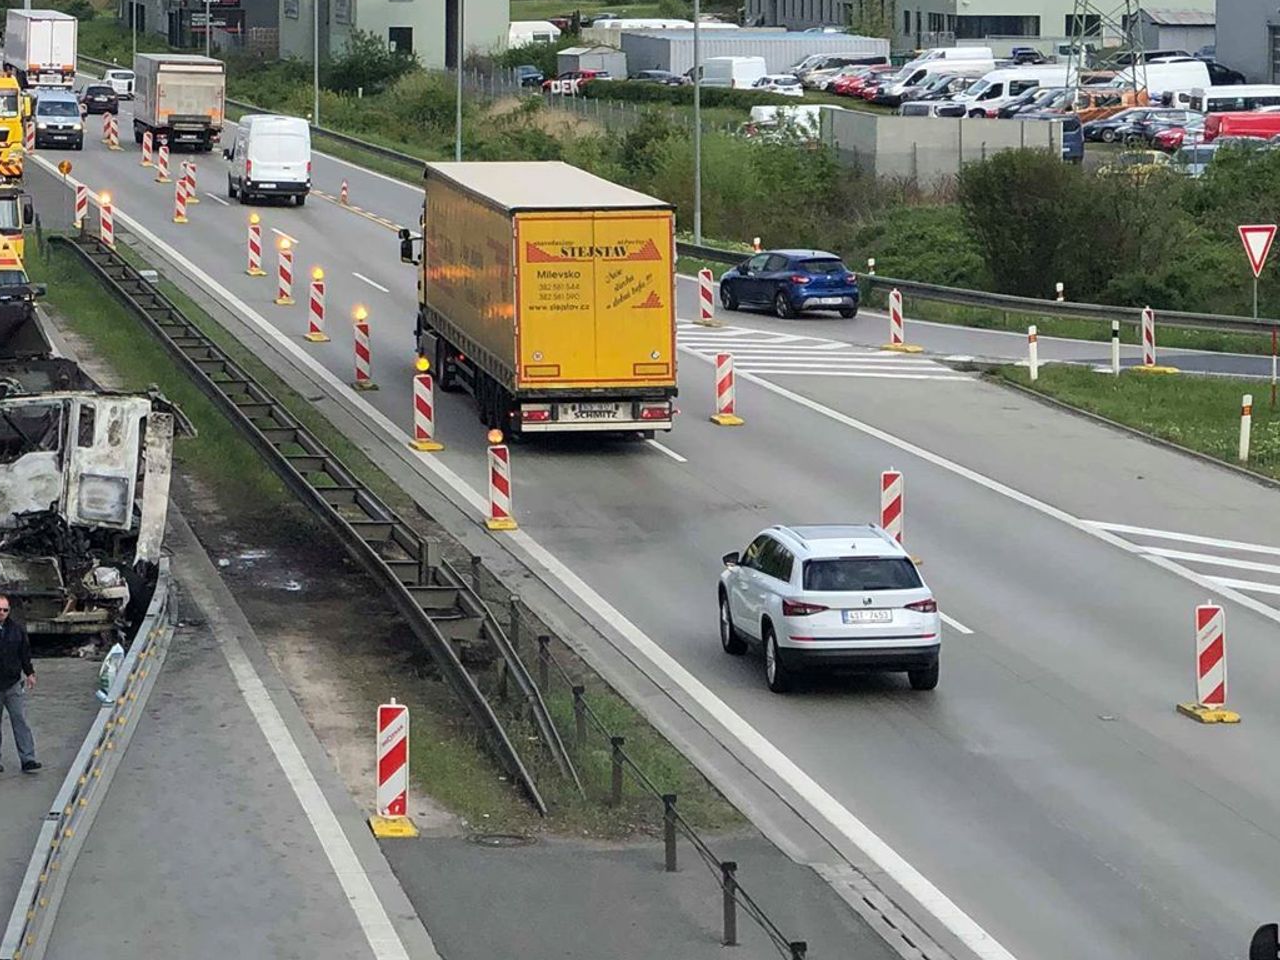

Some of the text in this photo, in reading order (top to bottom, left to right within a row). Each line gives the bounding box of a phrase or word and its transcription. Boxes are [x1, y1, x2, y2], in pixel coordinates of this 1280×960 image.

[551, 78, 582, 96] DEK
[560, 246, 626, 258] STEJSTAV
[537, 270, 581, 279] Milevsko
[573, 411, 618, 419] SCHMITZ
